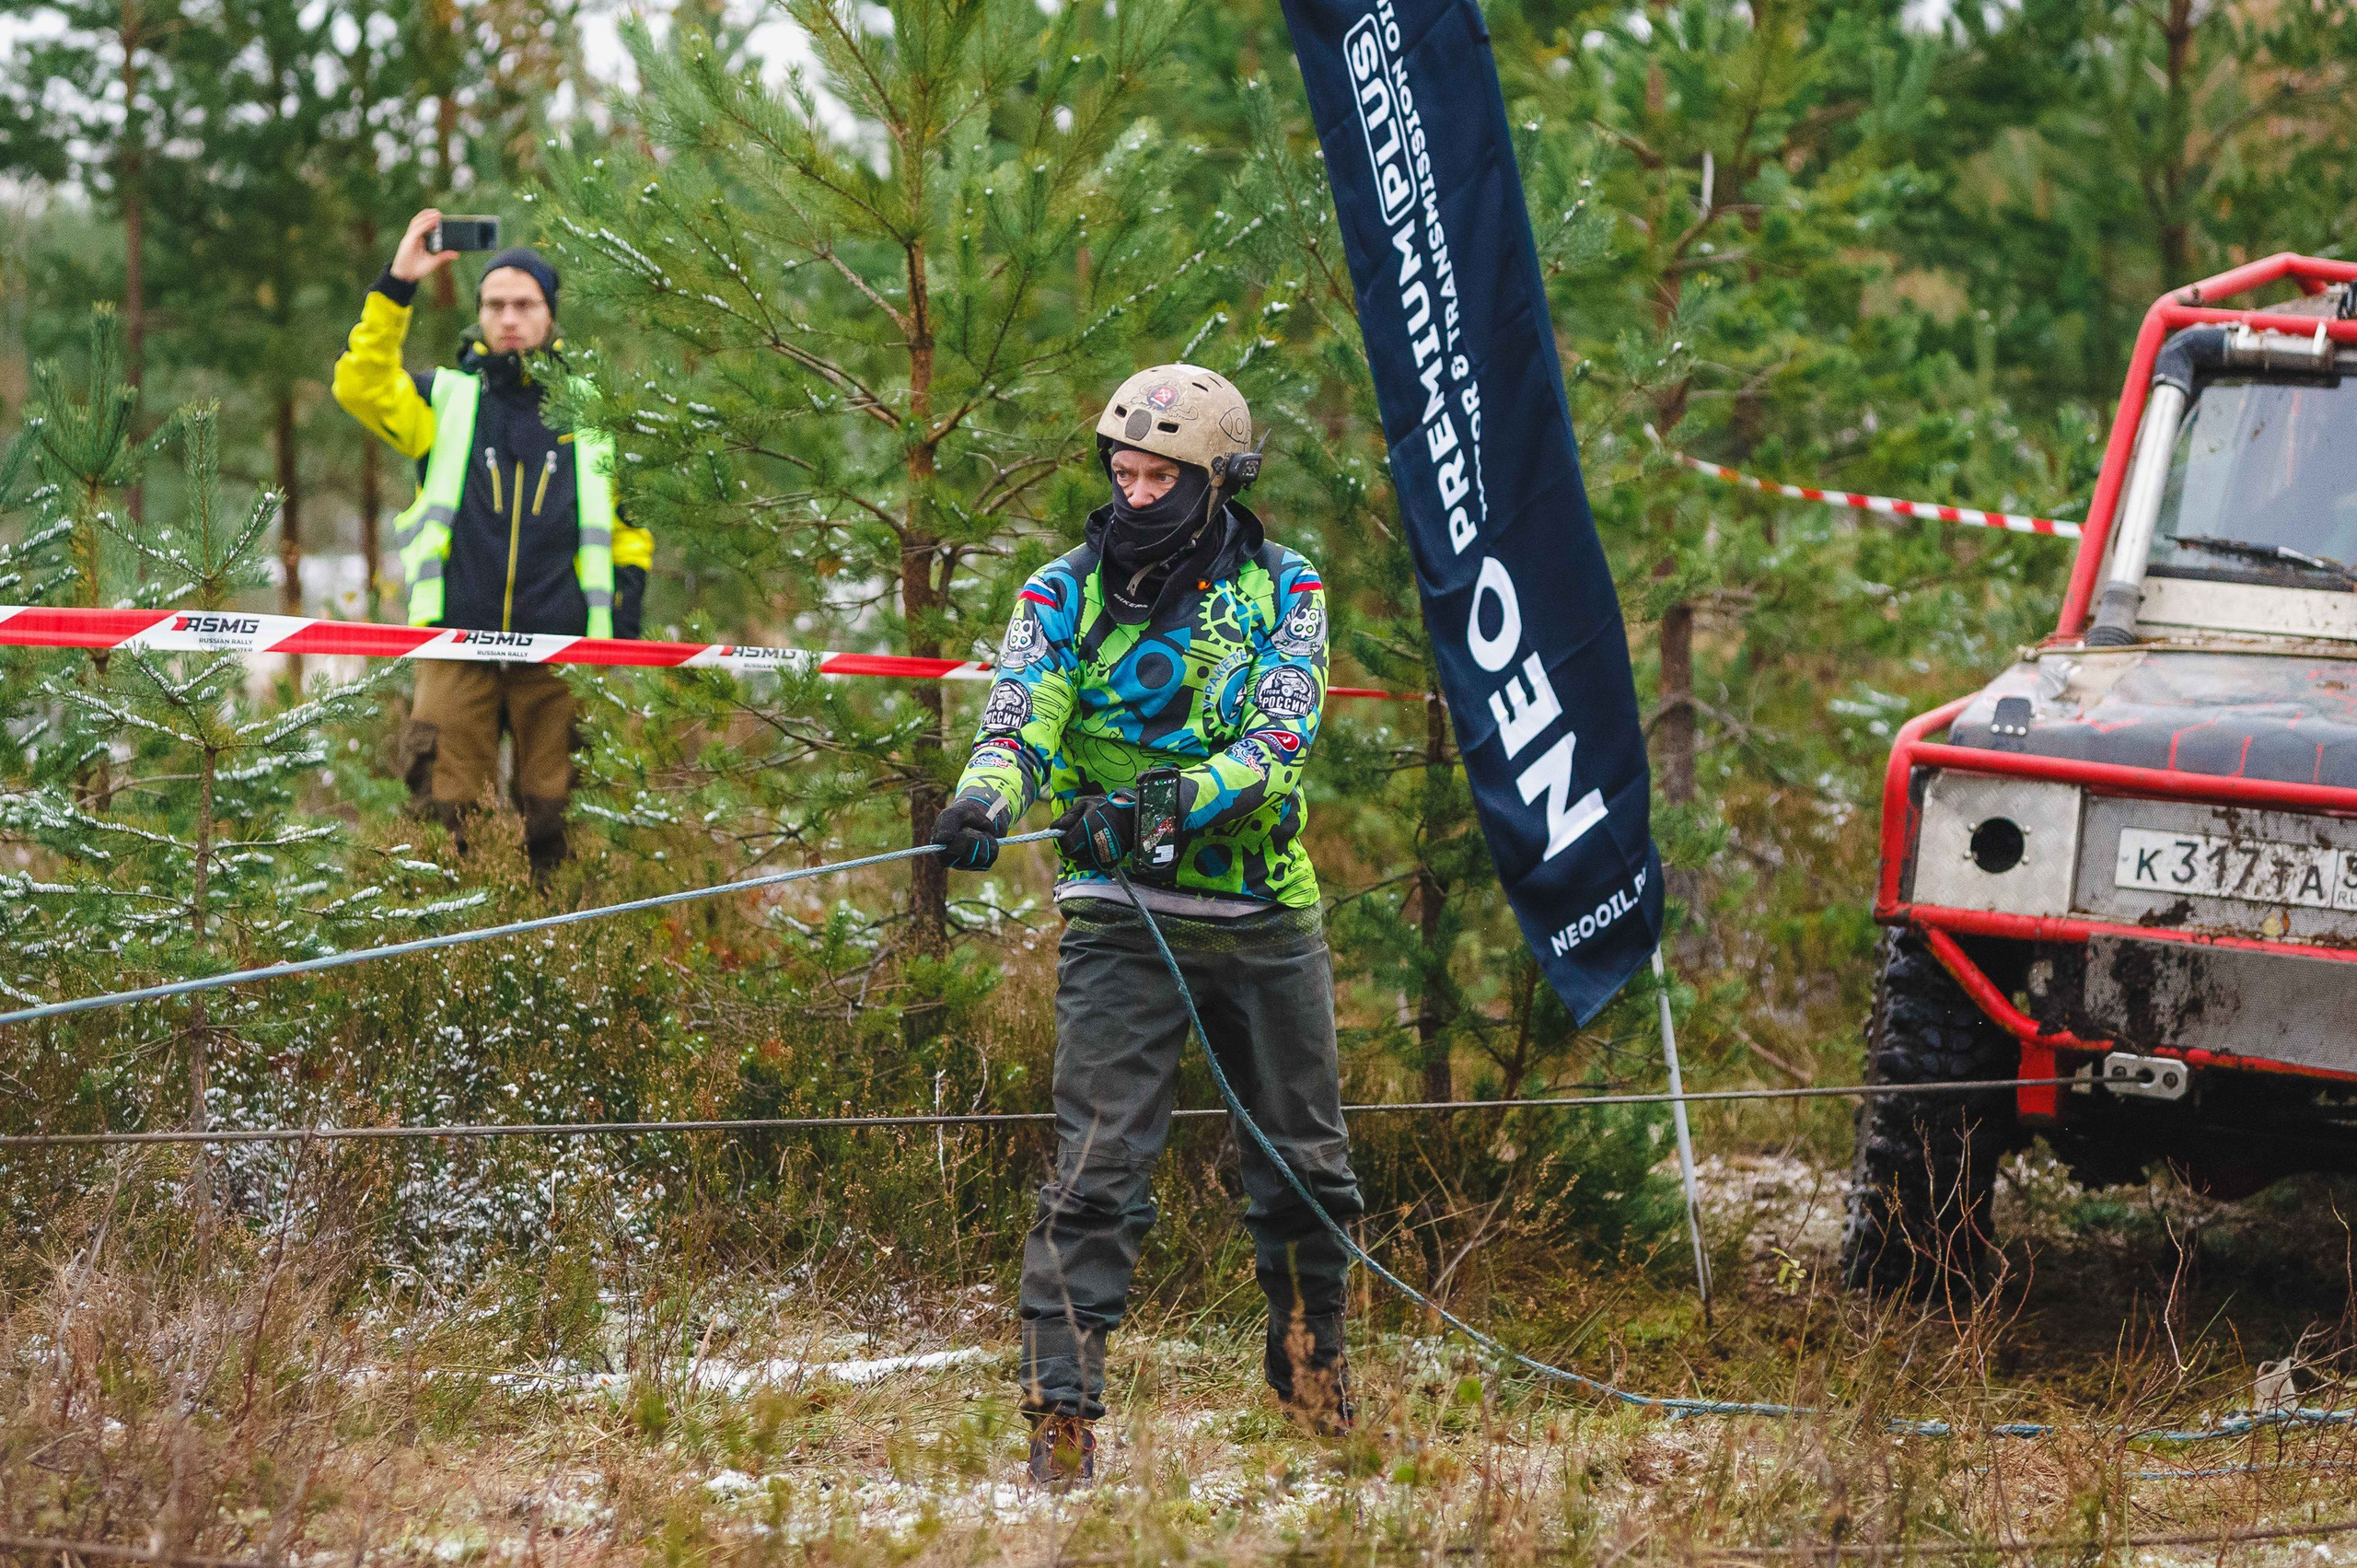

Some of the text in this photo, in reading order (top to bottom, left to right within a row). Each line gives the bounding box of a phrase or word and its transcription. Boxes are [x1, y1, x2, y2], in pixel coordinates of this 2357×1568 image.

[1376, 0, 1470, 381] & TRANSMISSION OI
[1352, 30, 1477, 554] PREMIUM PLUS
[183, 616, 261, 634] ASMG
[199, 636, 230, 645] RUSSIAN
[1261, 696, 1307, 714] РОССИИ
[1467, 555, 1609, 863] NEO
